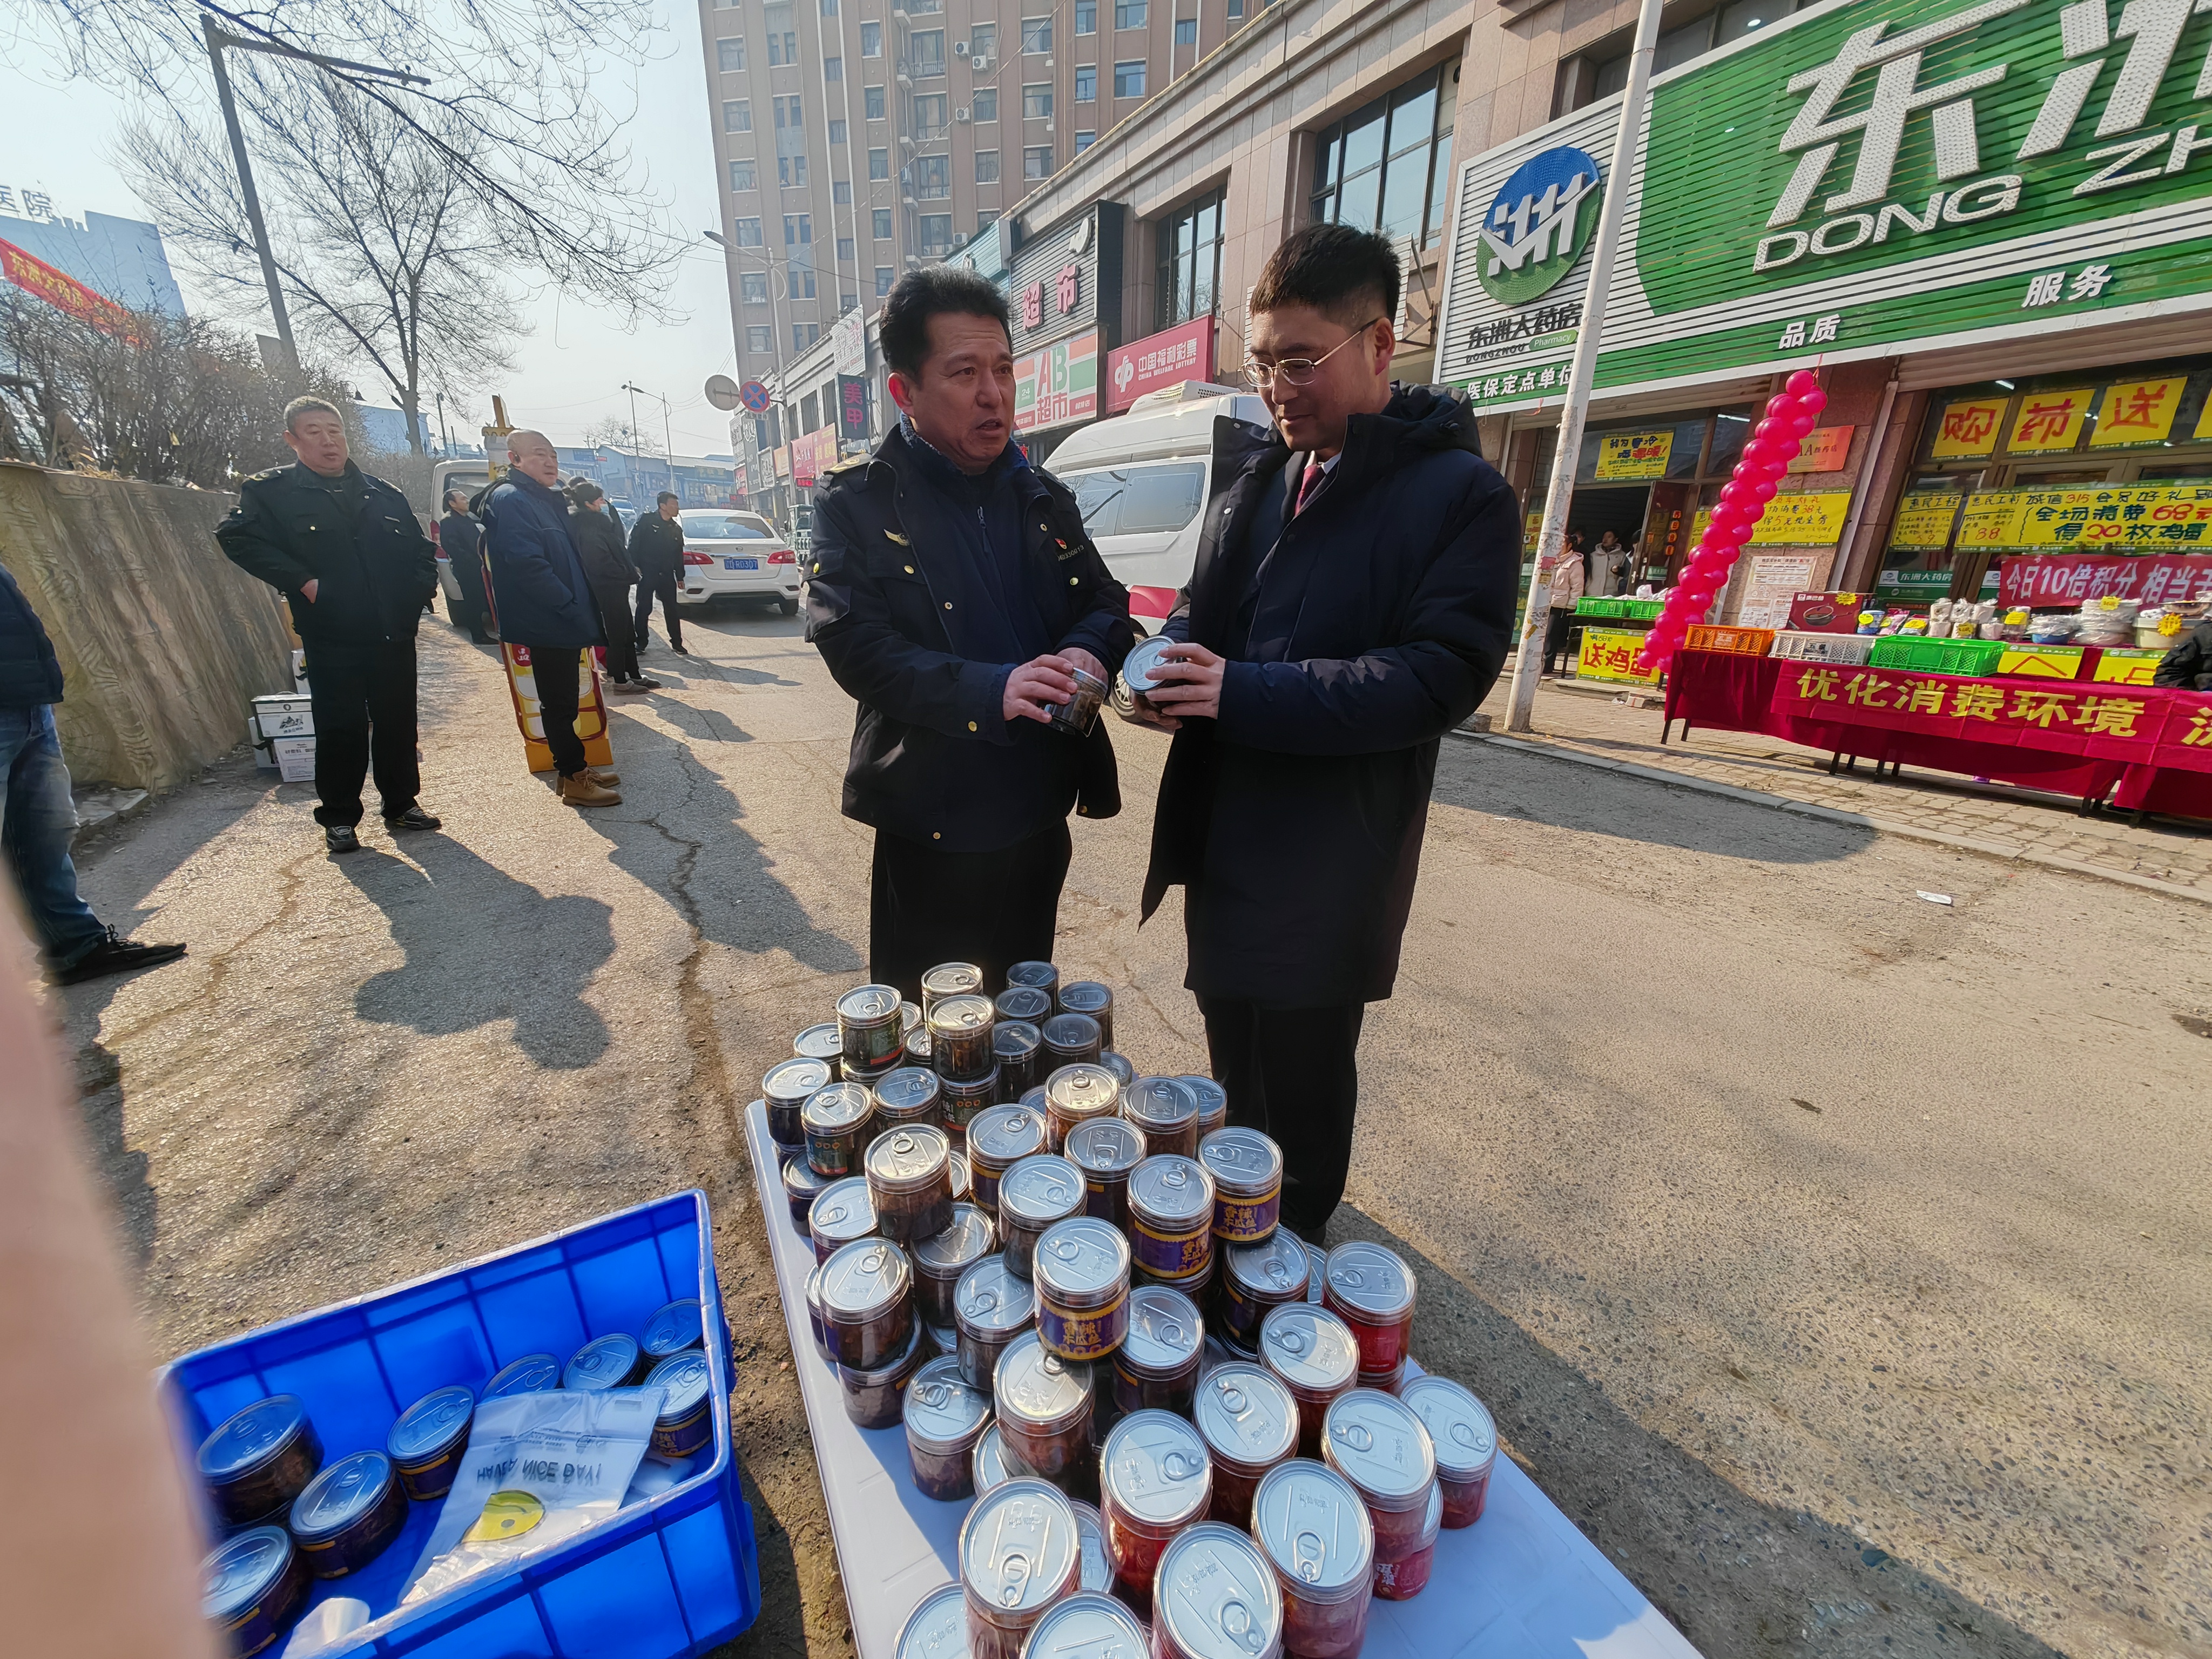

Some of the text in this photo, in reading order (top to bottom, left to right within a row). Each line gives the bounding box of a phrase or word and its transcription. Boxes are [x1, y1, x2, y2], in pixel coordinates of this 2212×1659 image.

[1753, 174, 2022, 273] DONG
[1022, 263, 1078, 332] 超市
[1778, 263, 2113, 350] 品质 服务
[1468, 302, 1584, 349] 东洲大药房
[1138, 338, 1197, 373] 中国福利彩票
[1138, 356, 1196, 381] CHINA WELFARE LOTTERY
[1466, 333, 1572, 363] DONGZHOU Pharmacy
[1037, 345, 1068, 397] AB
[1467, 363, 1573, 400] 医保定点单位
[844, 381, 863, 430] 美甲
[1037, 392, 1068, 425] 超市
[2053, 522, 2208, 541] 得20枚鸡蛋
[2006, 562, 2137, 602] 今日10倍积分
[1796, 667, 2146, 737] 优化消费环境
